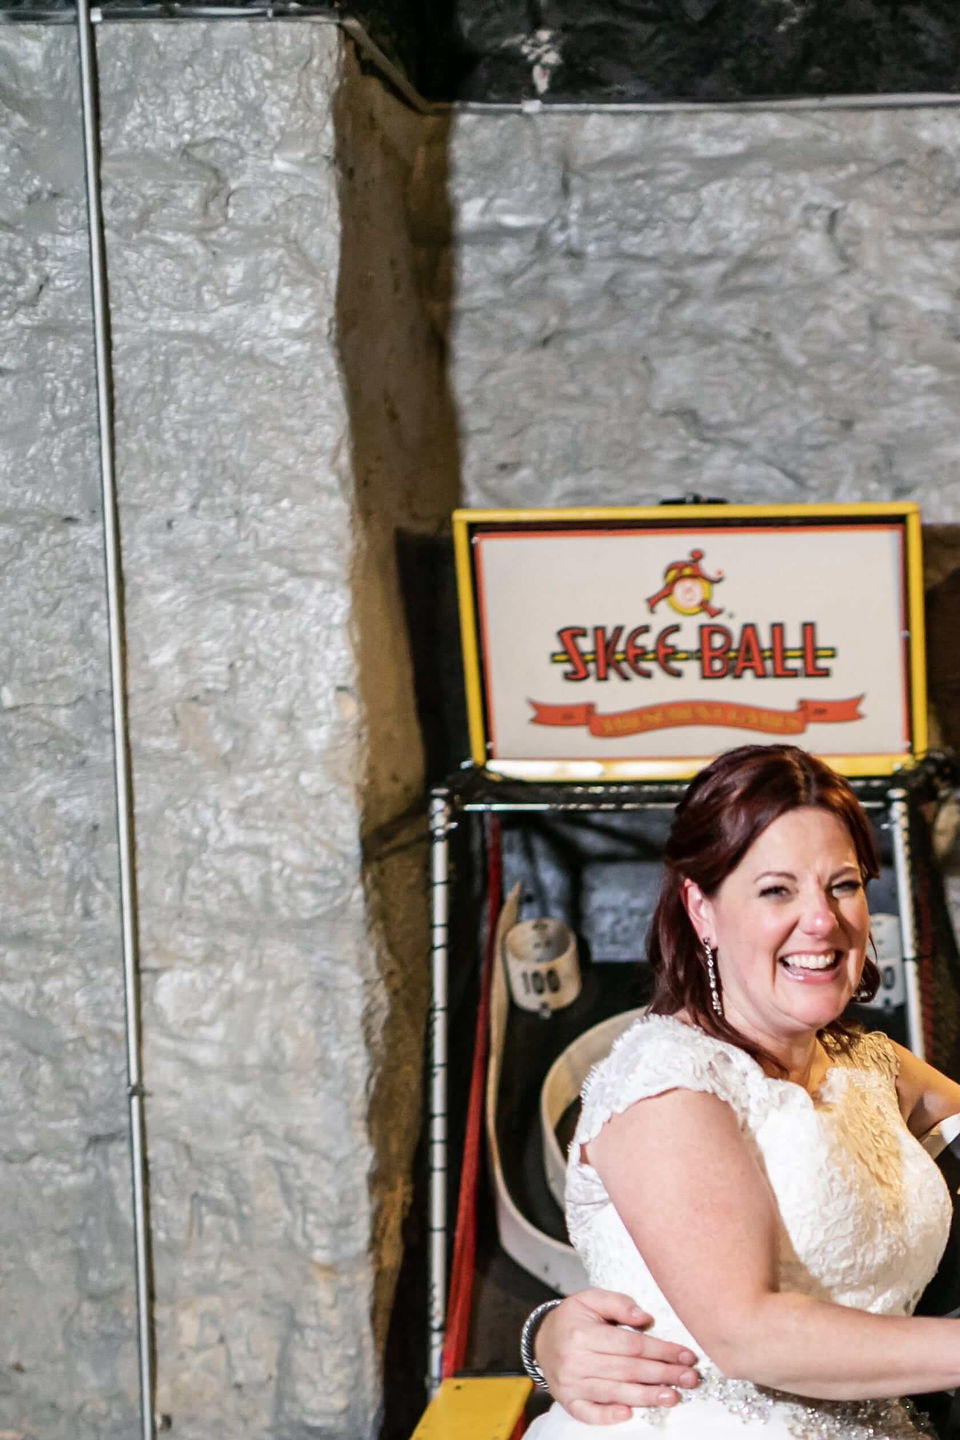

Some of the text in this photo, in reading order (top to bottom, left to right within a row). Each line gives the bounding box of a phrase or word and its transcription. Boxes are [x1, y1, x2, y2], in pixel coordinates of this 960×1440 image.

[556, 622, 832, 682] SKEE BALL
[521, 968, 561, 996] 100
